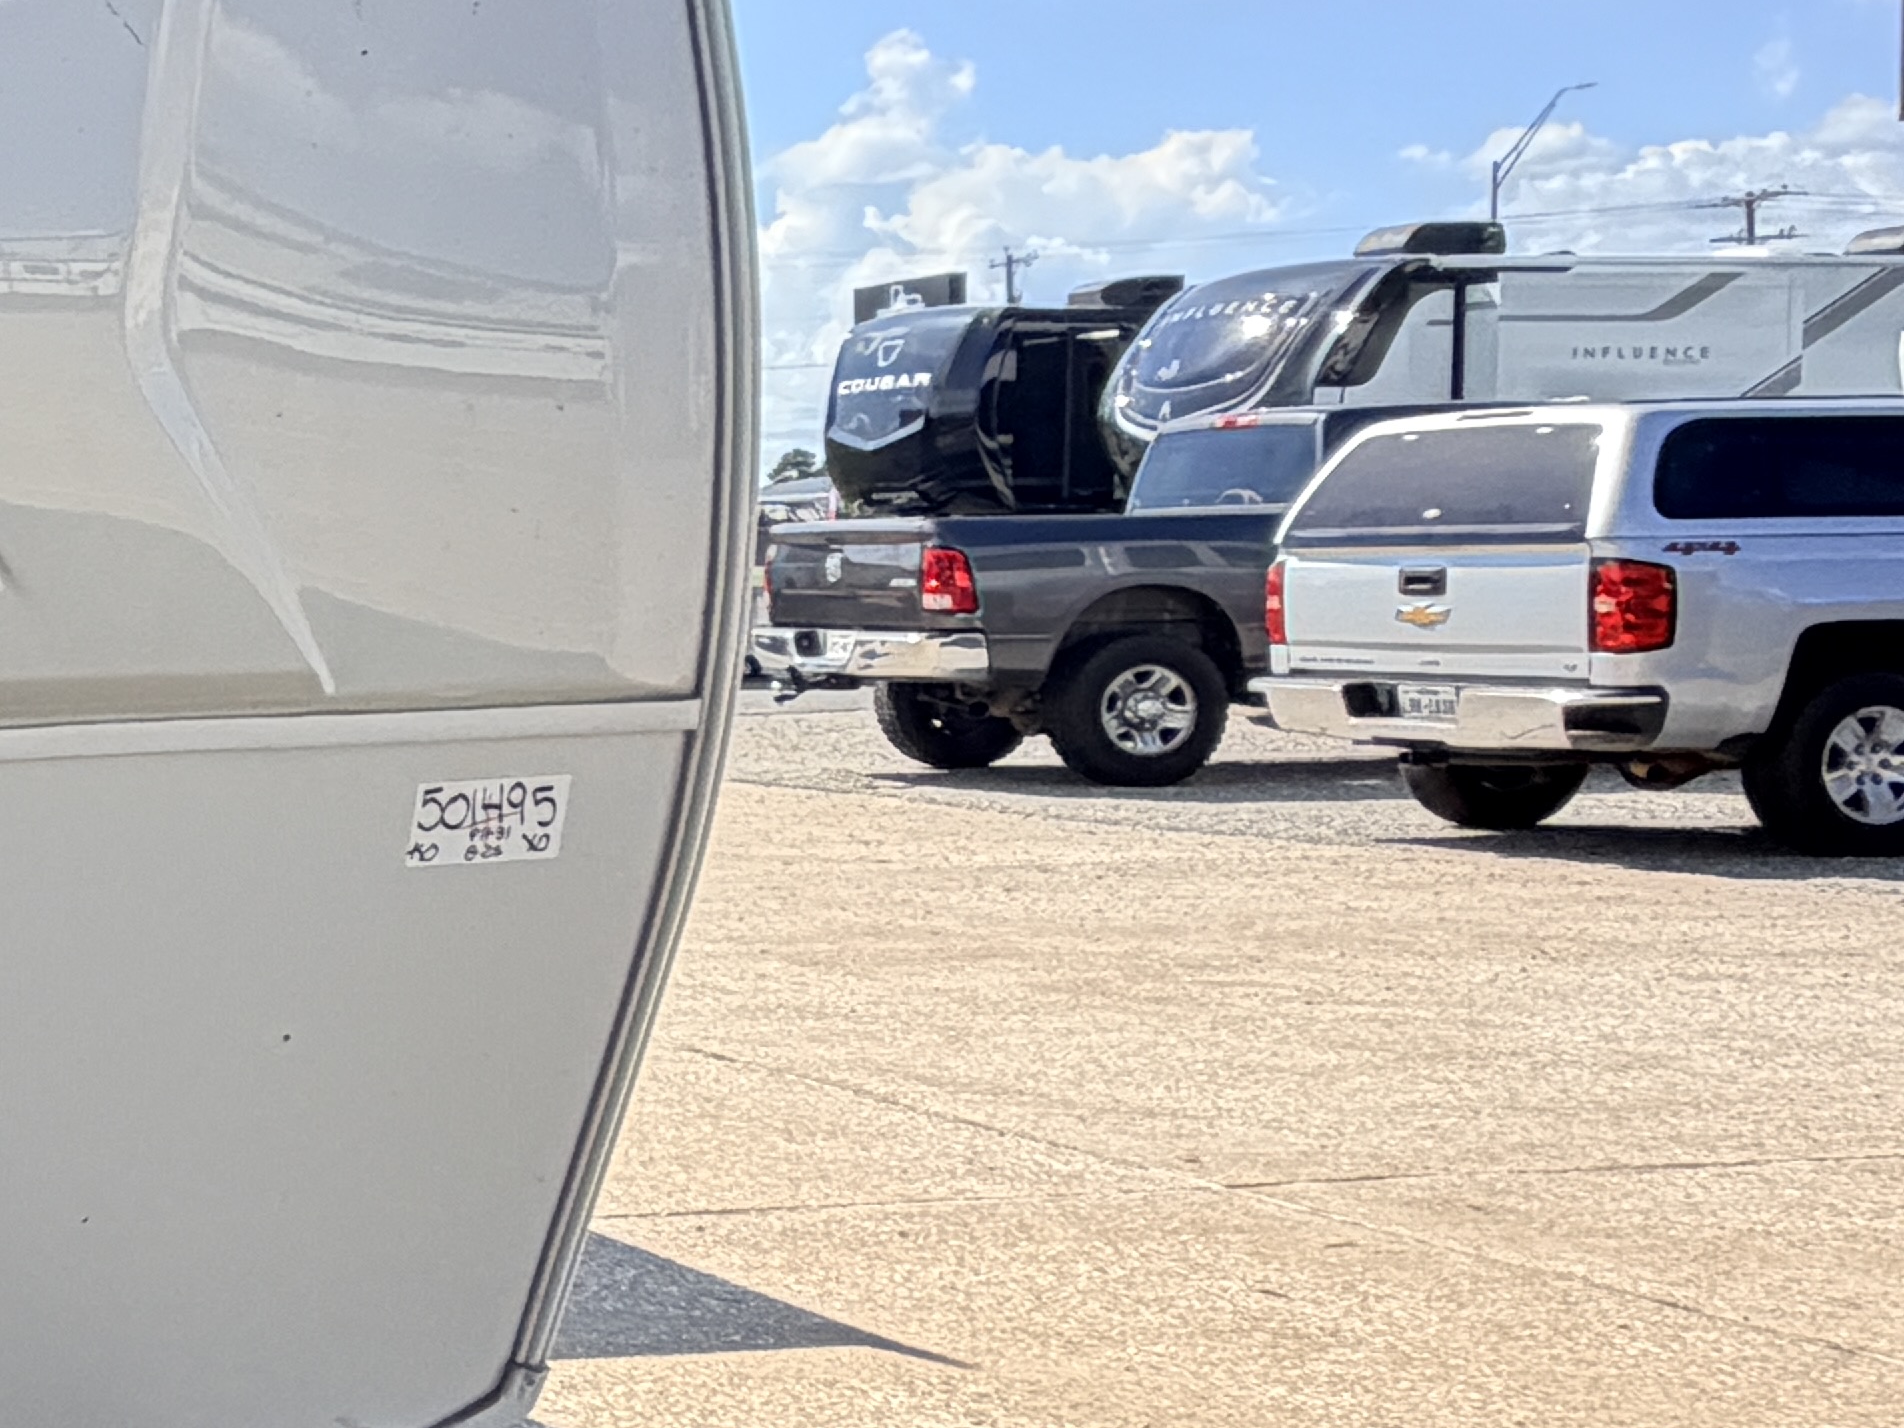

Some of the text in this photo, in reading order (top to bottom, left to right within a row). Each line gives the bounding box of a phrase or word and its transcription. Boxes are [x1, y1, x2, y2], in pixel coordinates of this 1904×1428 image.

[1571, 345, 1711, 360] INFLUENCE
[837, 372, 933, 396] COUGAR
[416, 781, 557, 832] 501495
